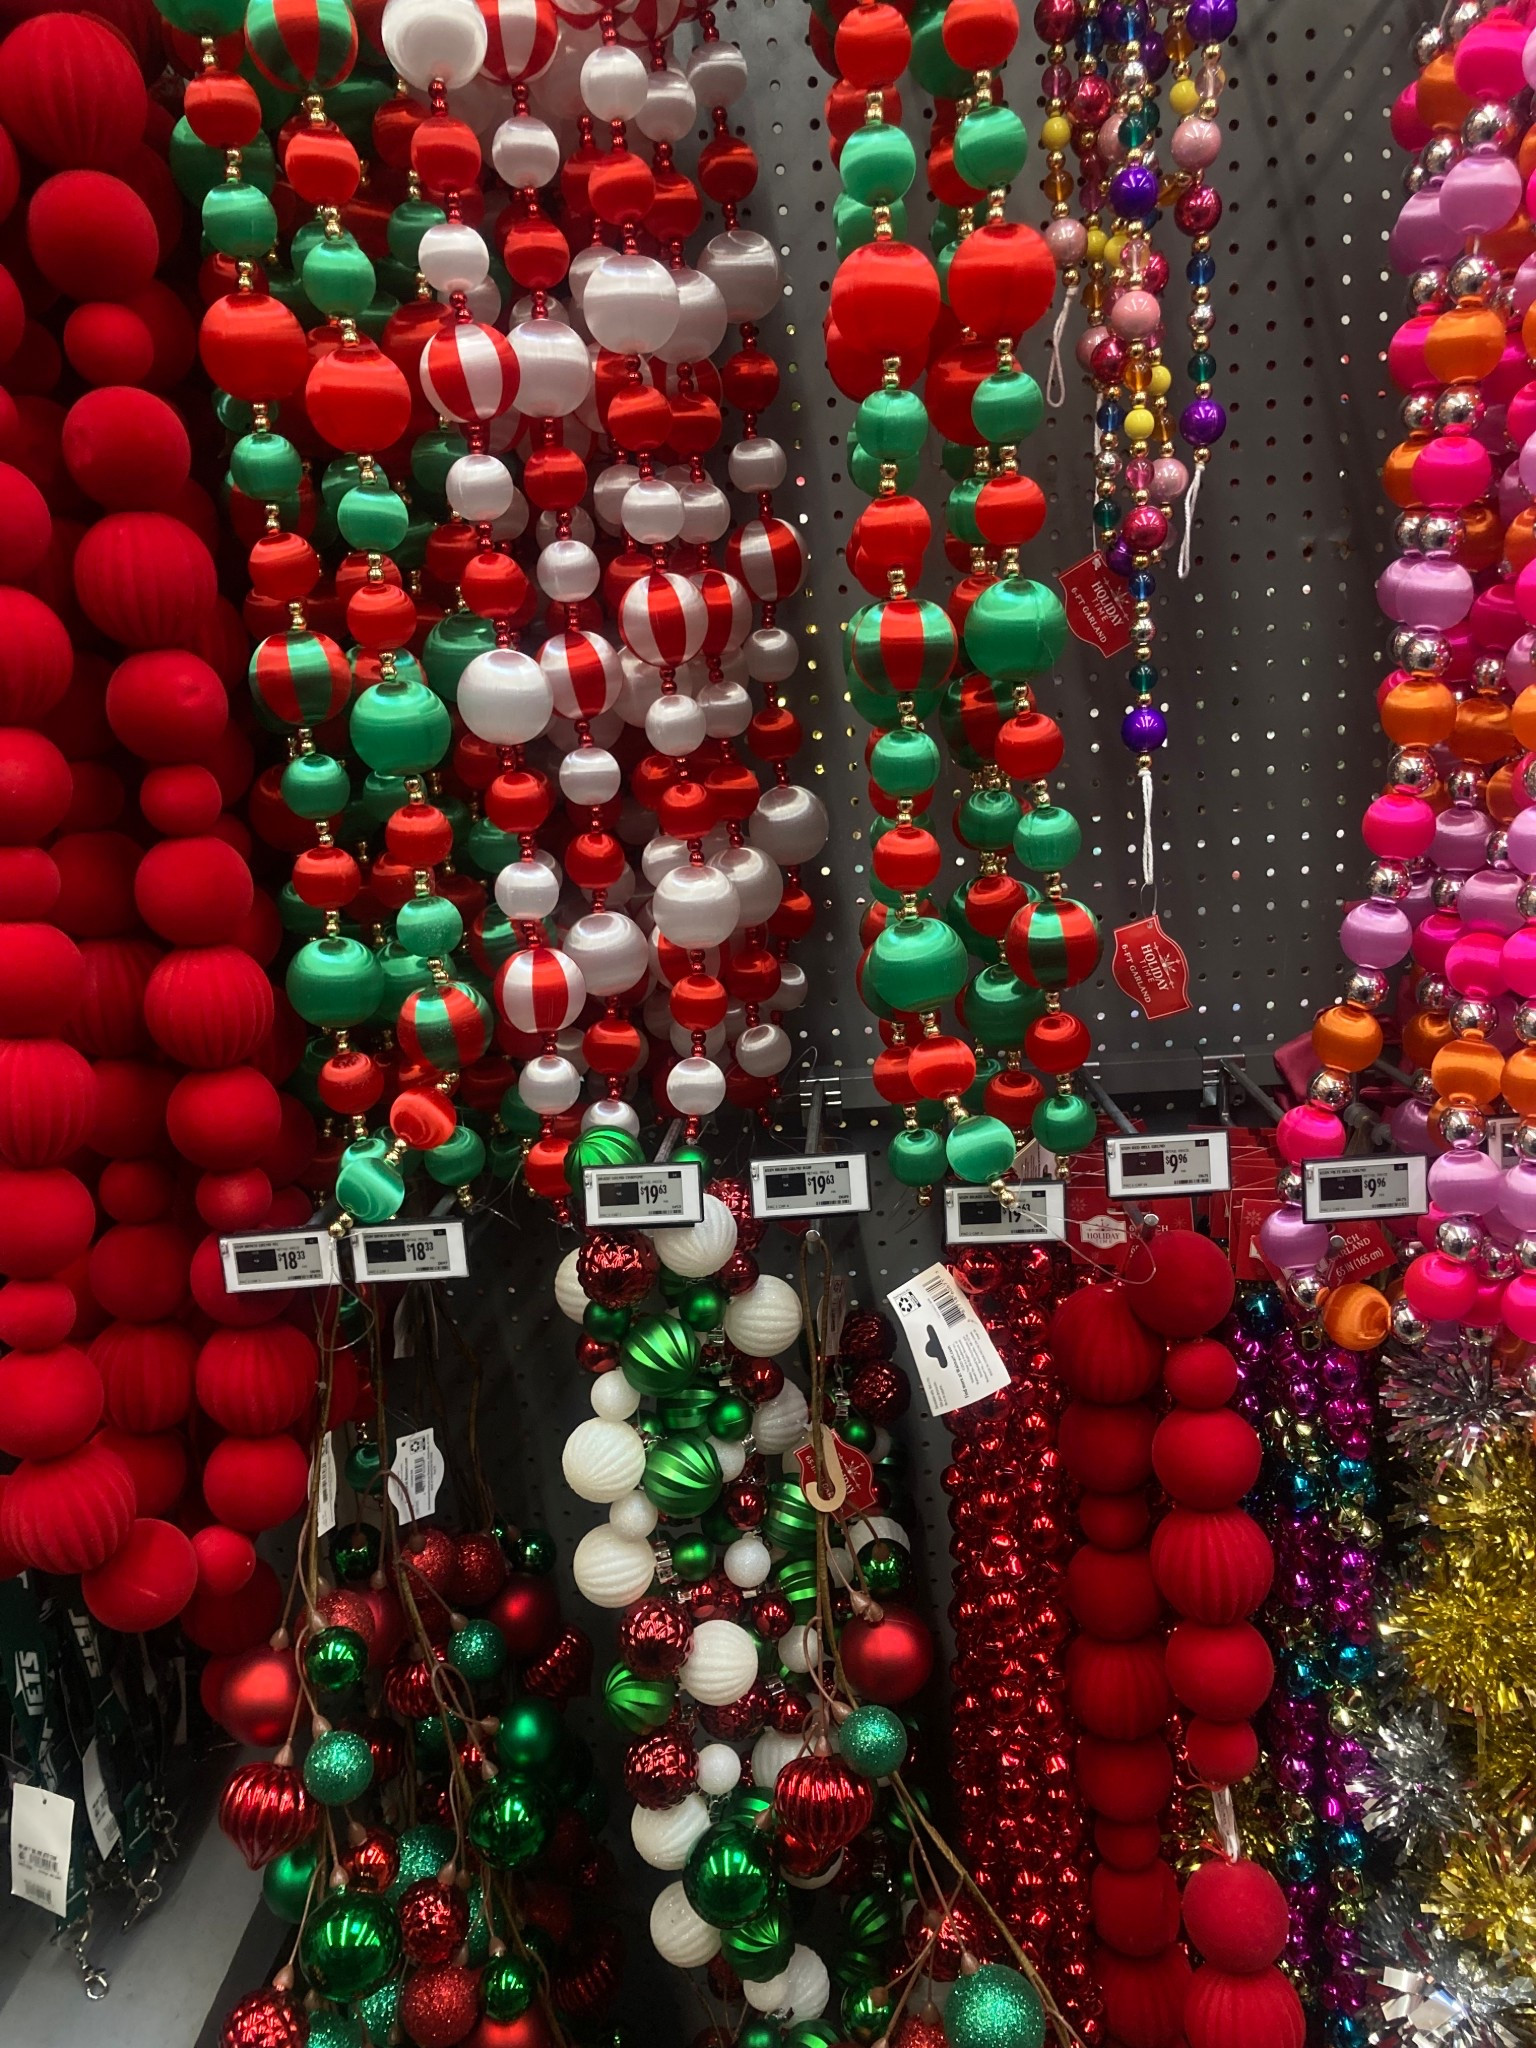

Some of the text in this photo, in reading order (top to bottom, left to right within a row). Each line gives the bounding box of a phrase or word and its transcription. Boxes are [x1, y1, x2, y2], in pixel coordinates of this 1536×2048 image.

[1071, 587, 1108, 643] 6-FT GARLAND
[1091, 580, 1125, 627] HOLIDAY
[1091, 598, 1110, 621] TIME
[1121, 943, 1152, 1003] 6-FT GARLAND
[1139, 960, 1156, 983] TIME
[1141, 943, 1169, 991] HOLIDAY
[1087, 1232, 1120, 1240] HOLIDAY
[1353, 1253, 1370, 1270] (165
[1369, 1247, 1385, 1261] cm)
